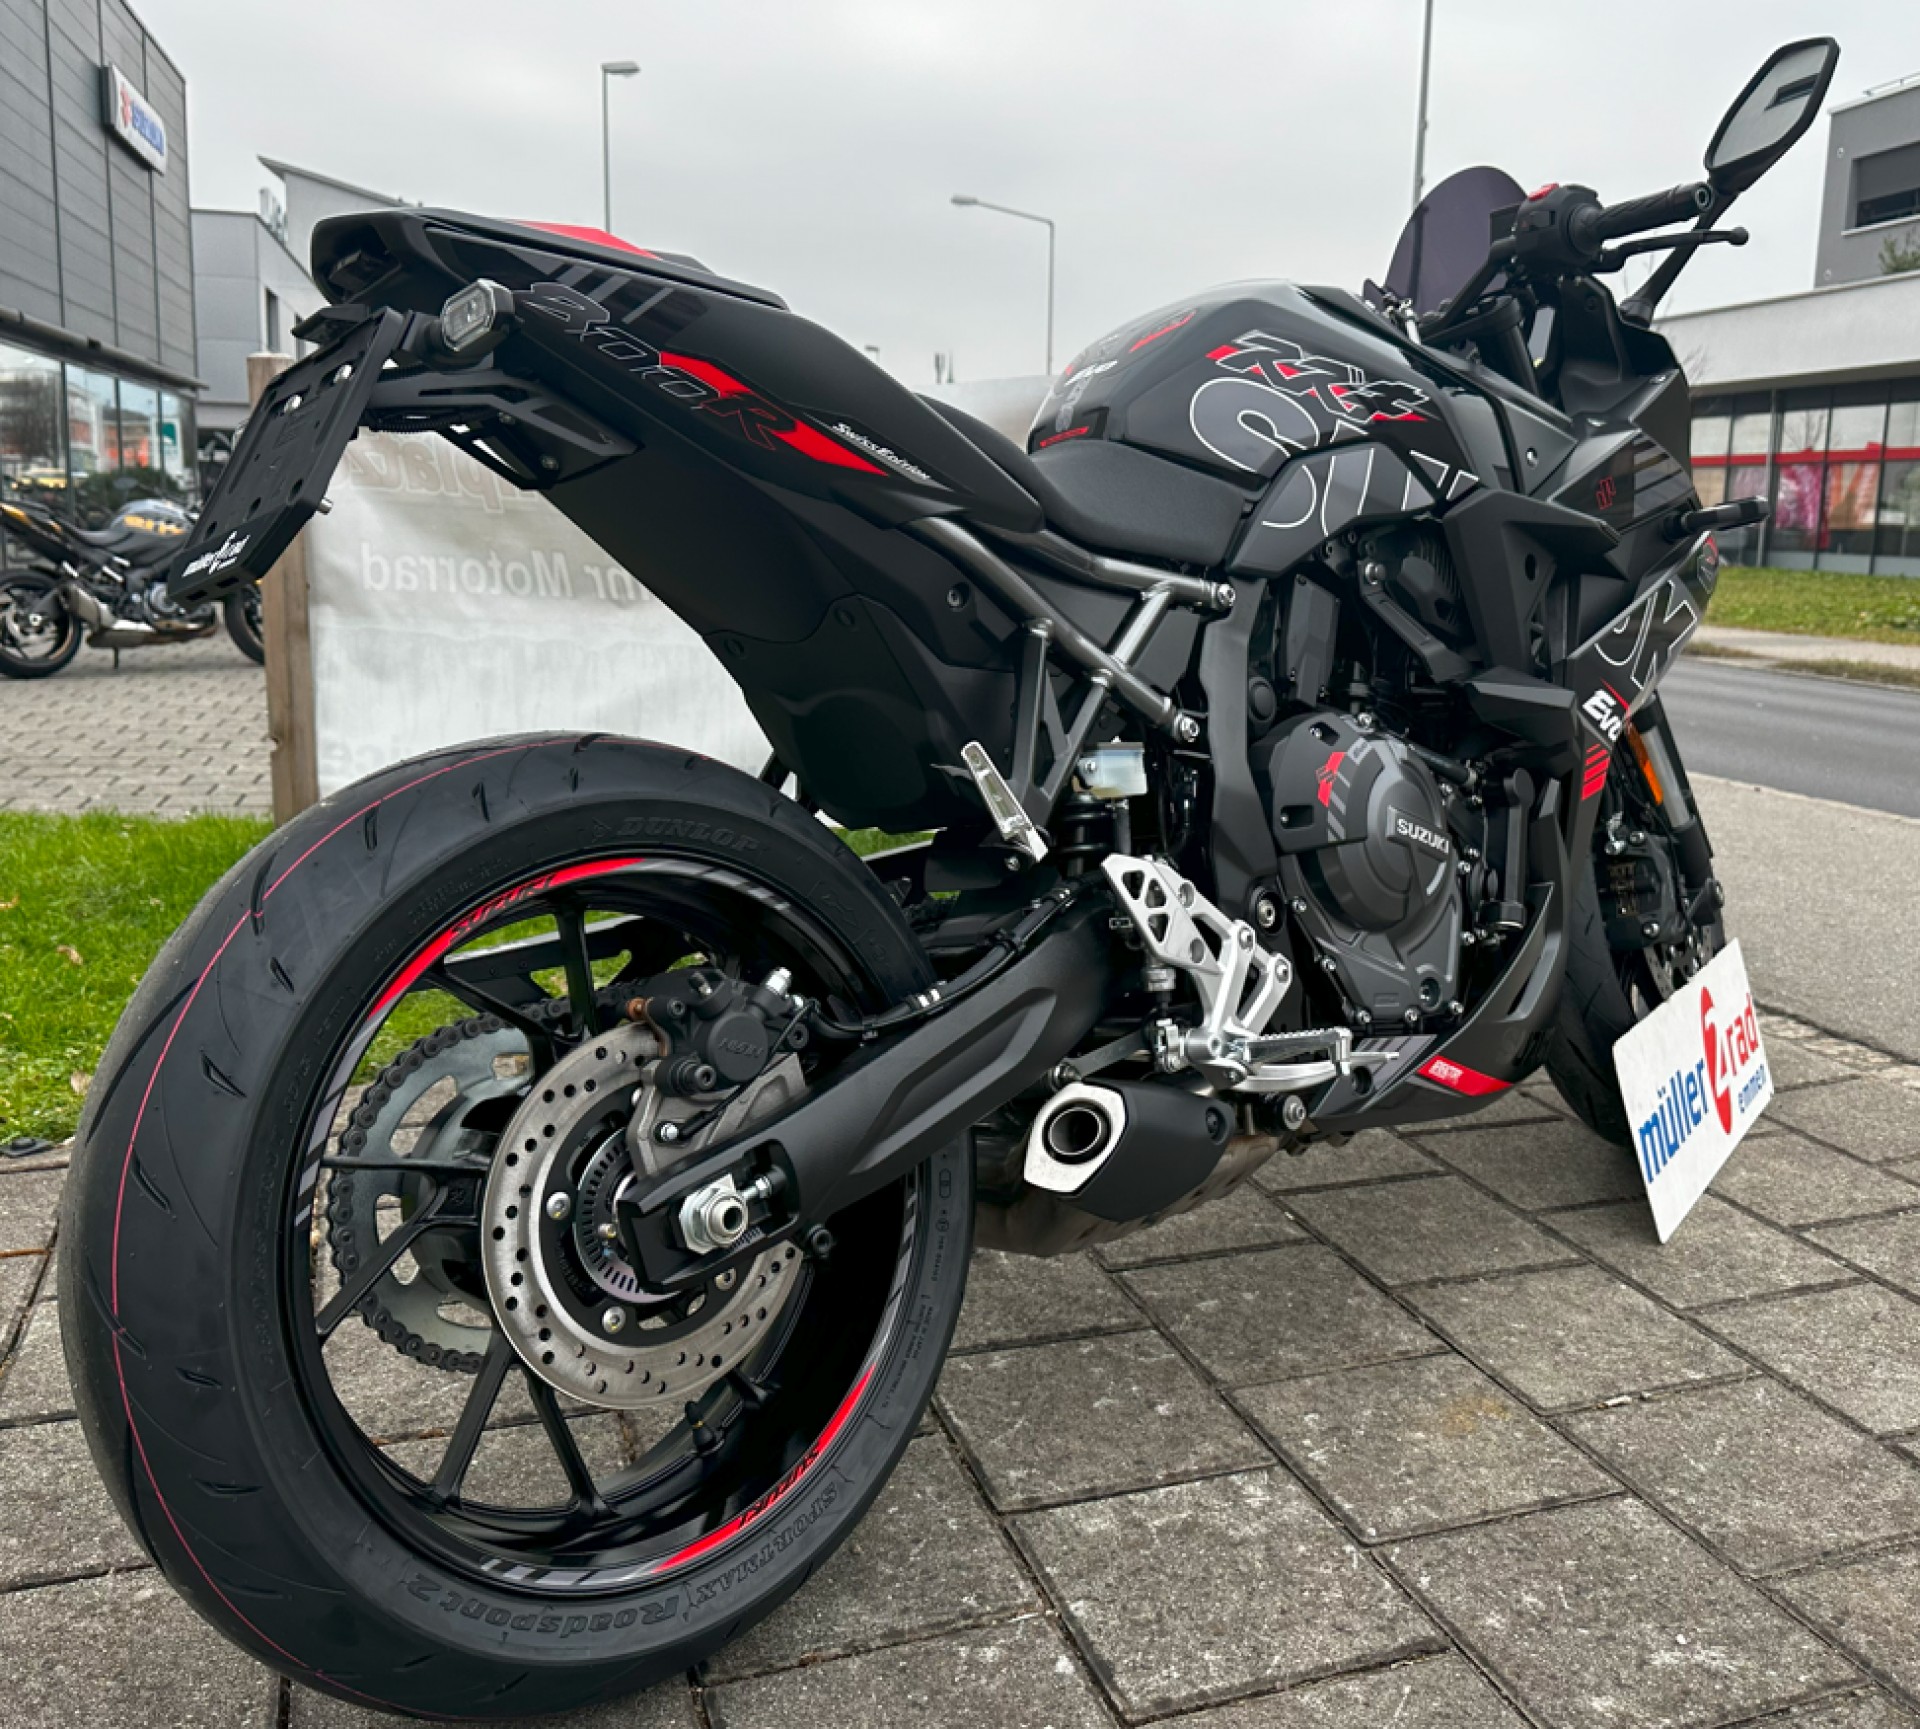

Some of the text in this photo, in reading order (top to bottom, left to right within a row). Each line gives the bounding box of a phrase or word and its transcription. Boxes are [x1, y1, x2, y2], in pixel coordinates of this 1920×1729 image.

[616, 816, 761, 852] DUNLOP
[1396, 817, 1450, 855] SUZUKI
[1637, 1057, 1709, 1184] müller
[407, 1481, 838, 1638] SPORTMAX Roadsport 2
